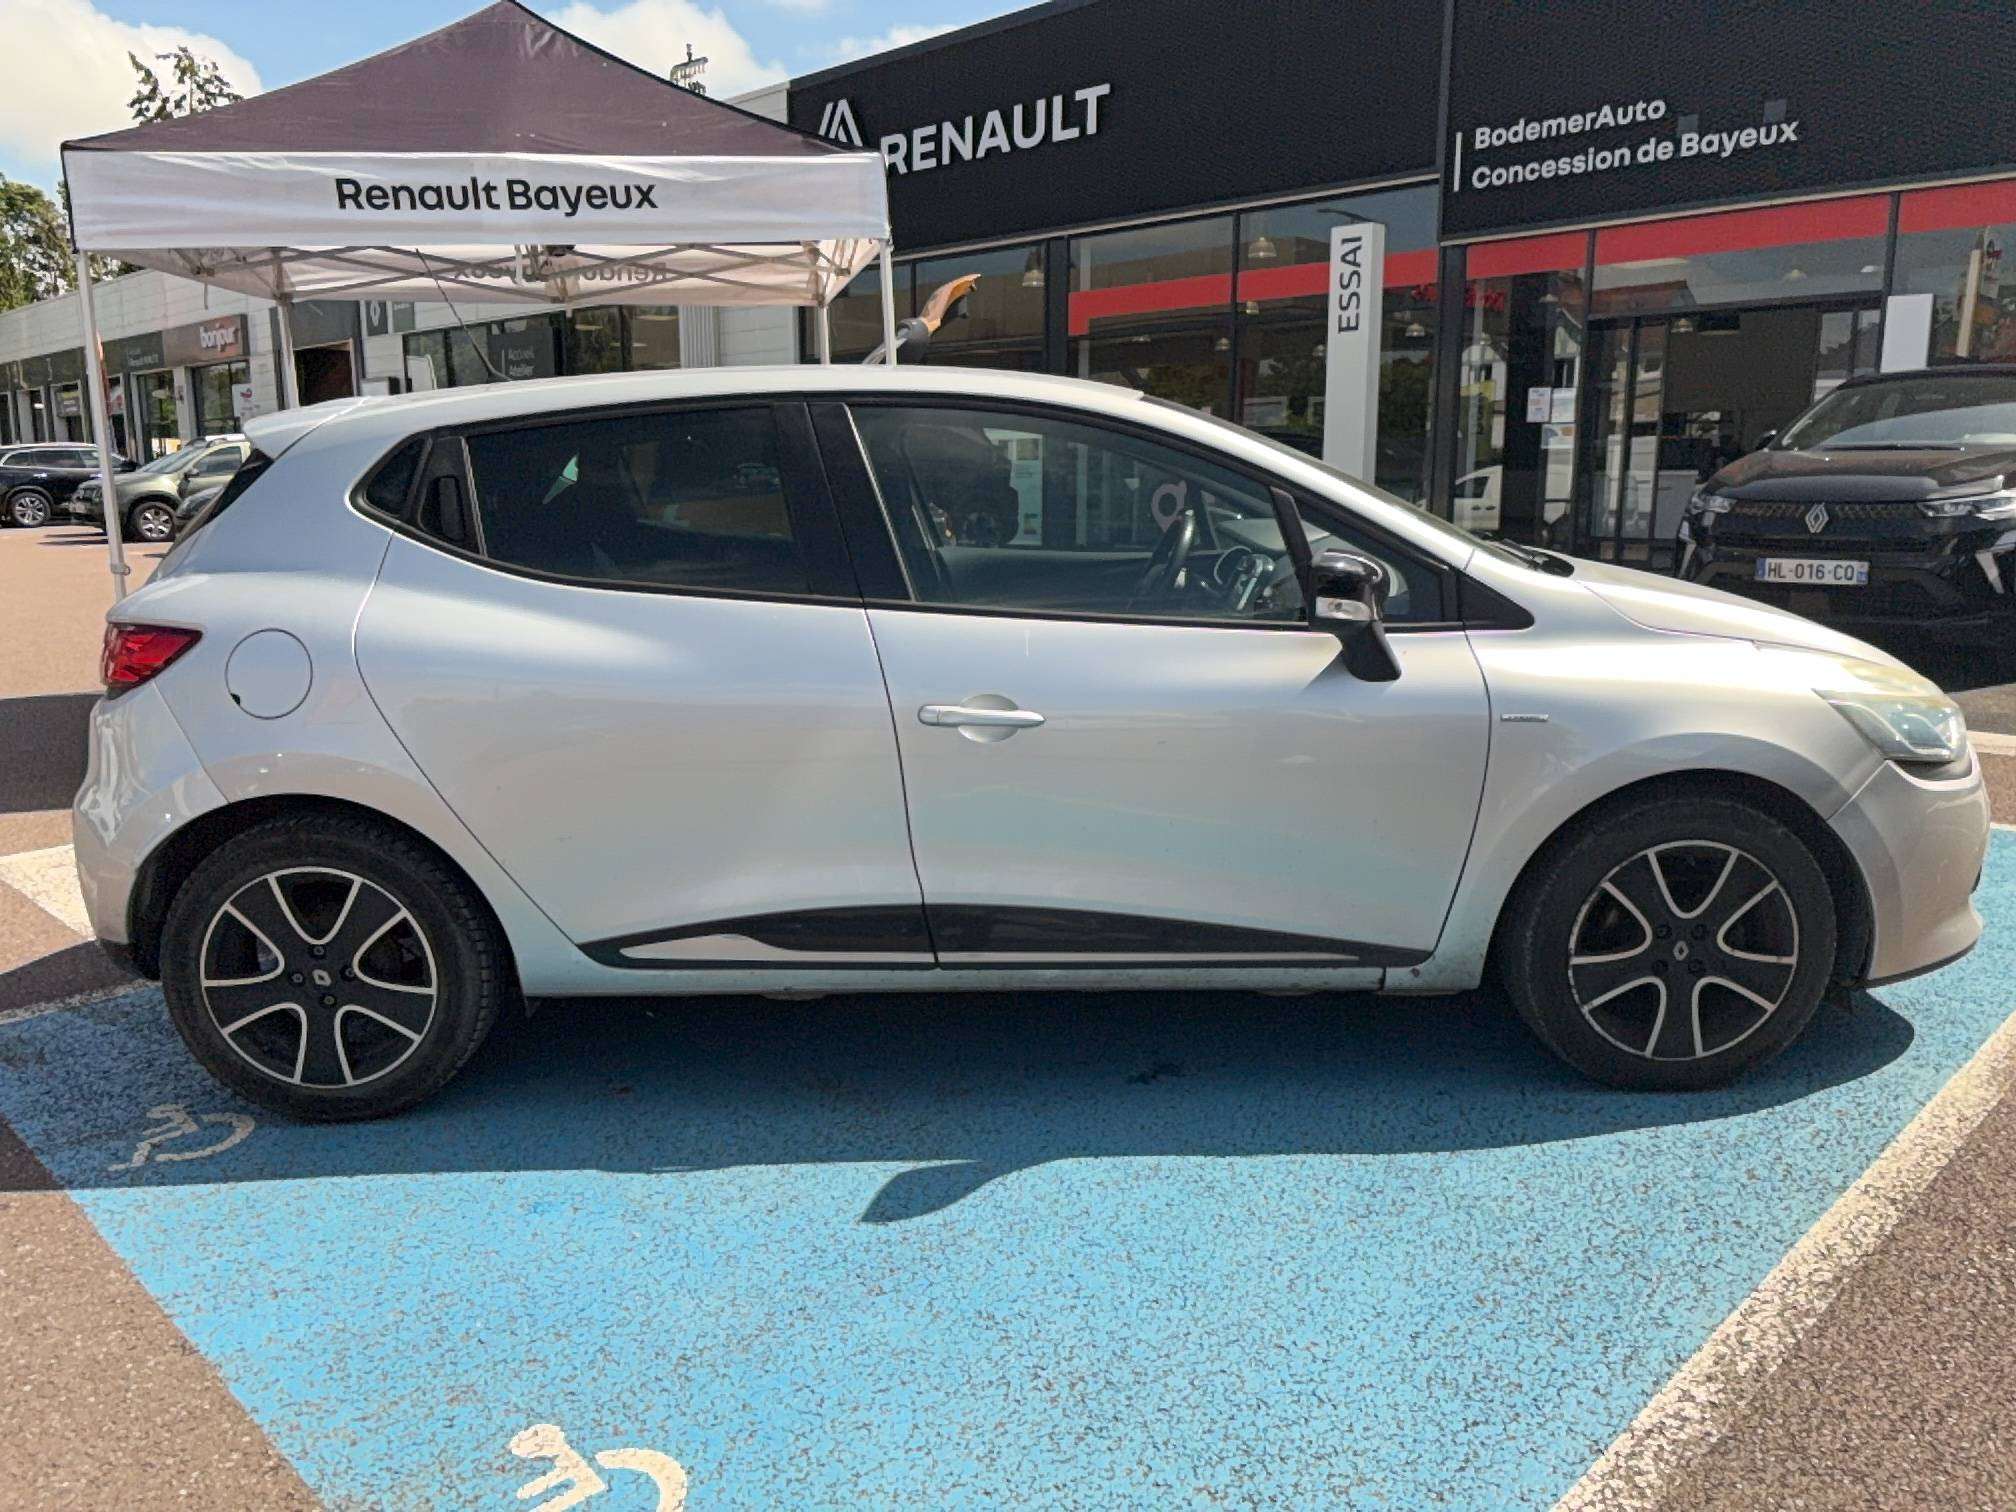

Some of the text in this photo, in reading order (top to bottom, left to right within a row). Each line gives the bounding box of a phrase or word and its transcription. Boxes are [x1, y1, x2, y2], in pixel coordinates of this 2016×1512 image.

[880, 83, 1111, 175] RENAULT
[1471, 120, 1800, 189] Concession de Bayeux
[1474, 99, 1667, 150] BodemerAuto
[335, 176, 659, 217] Renault Bayeux
[1338, 236, 1363, 334] ESSAI
